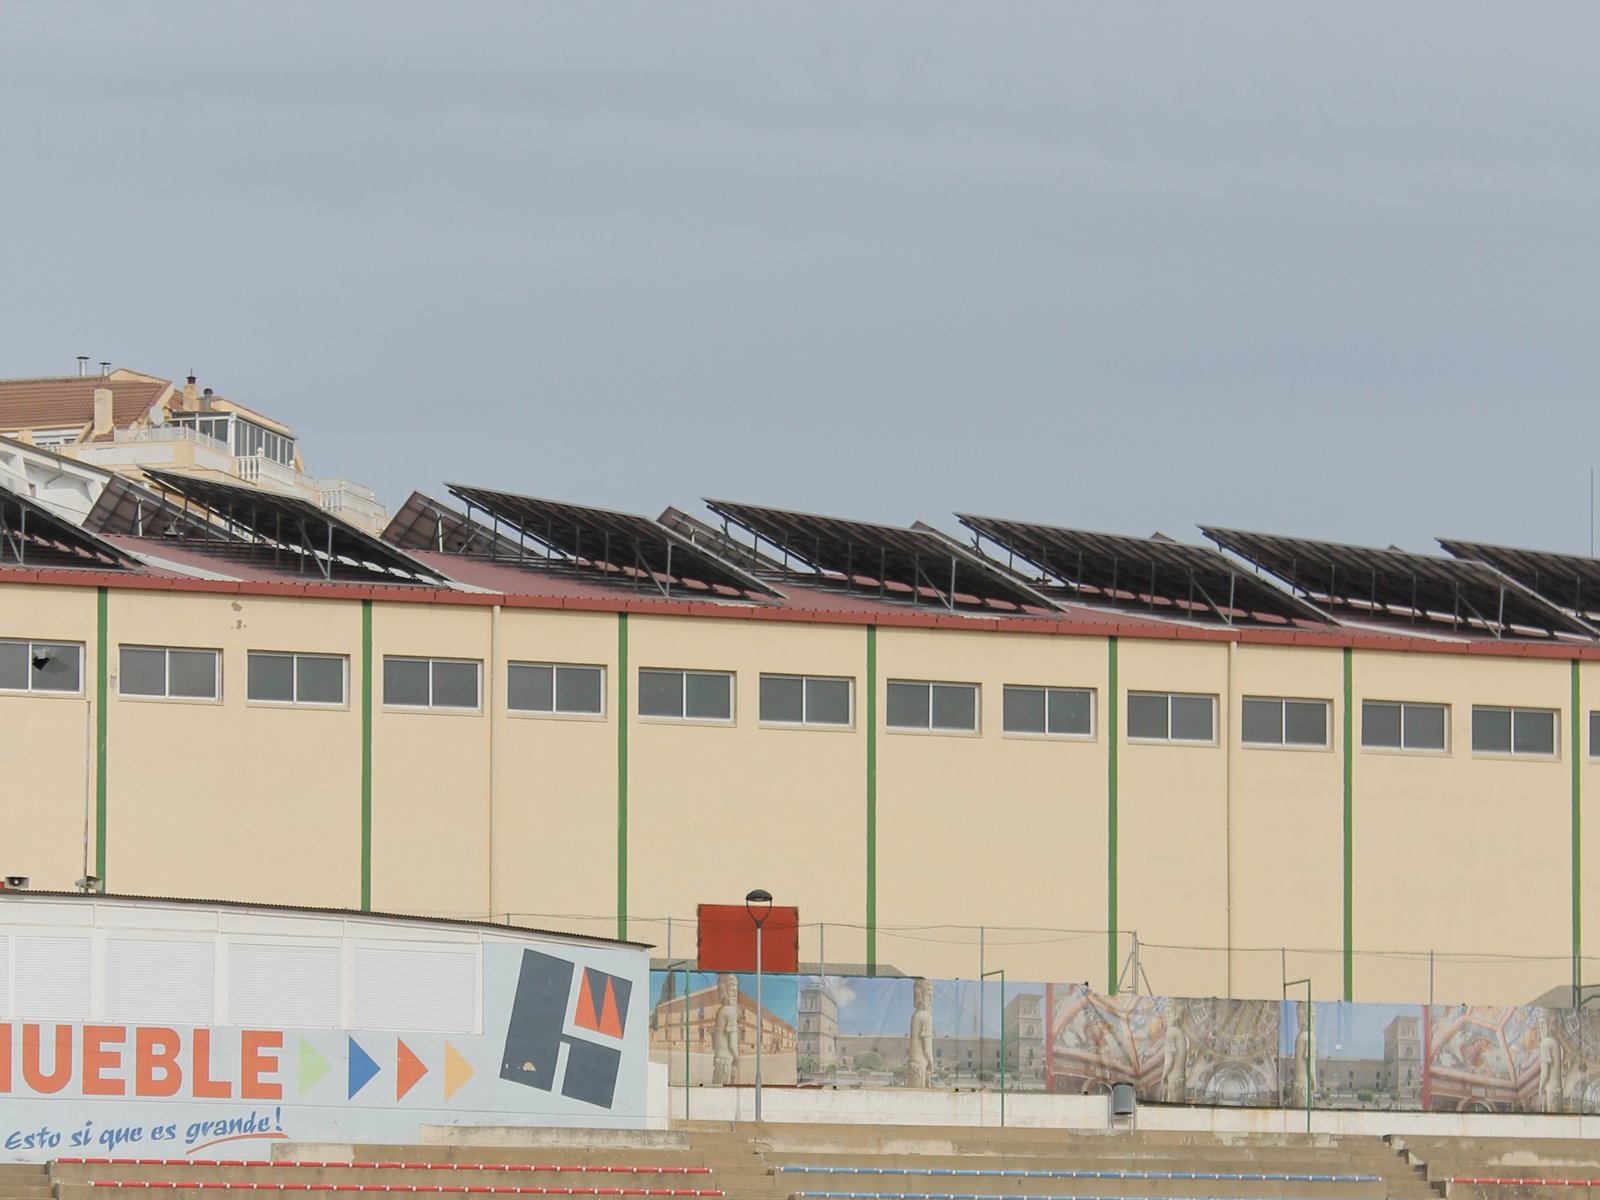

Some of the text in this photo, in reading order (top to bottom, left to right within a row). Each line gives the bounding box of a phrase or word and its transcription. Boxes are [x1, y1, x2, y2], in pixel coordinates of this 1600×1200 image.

[0, 1023, 283, 1100] UEBLE
[4, 1126, 61, 1150] Esto
[99, 1125, 143, 1152] que
[150, 1123, 176, 1141] es
[185, 1106, 282, 1145] grande!
